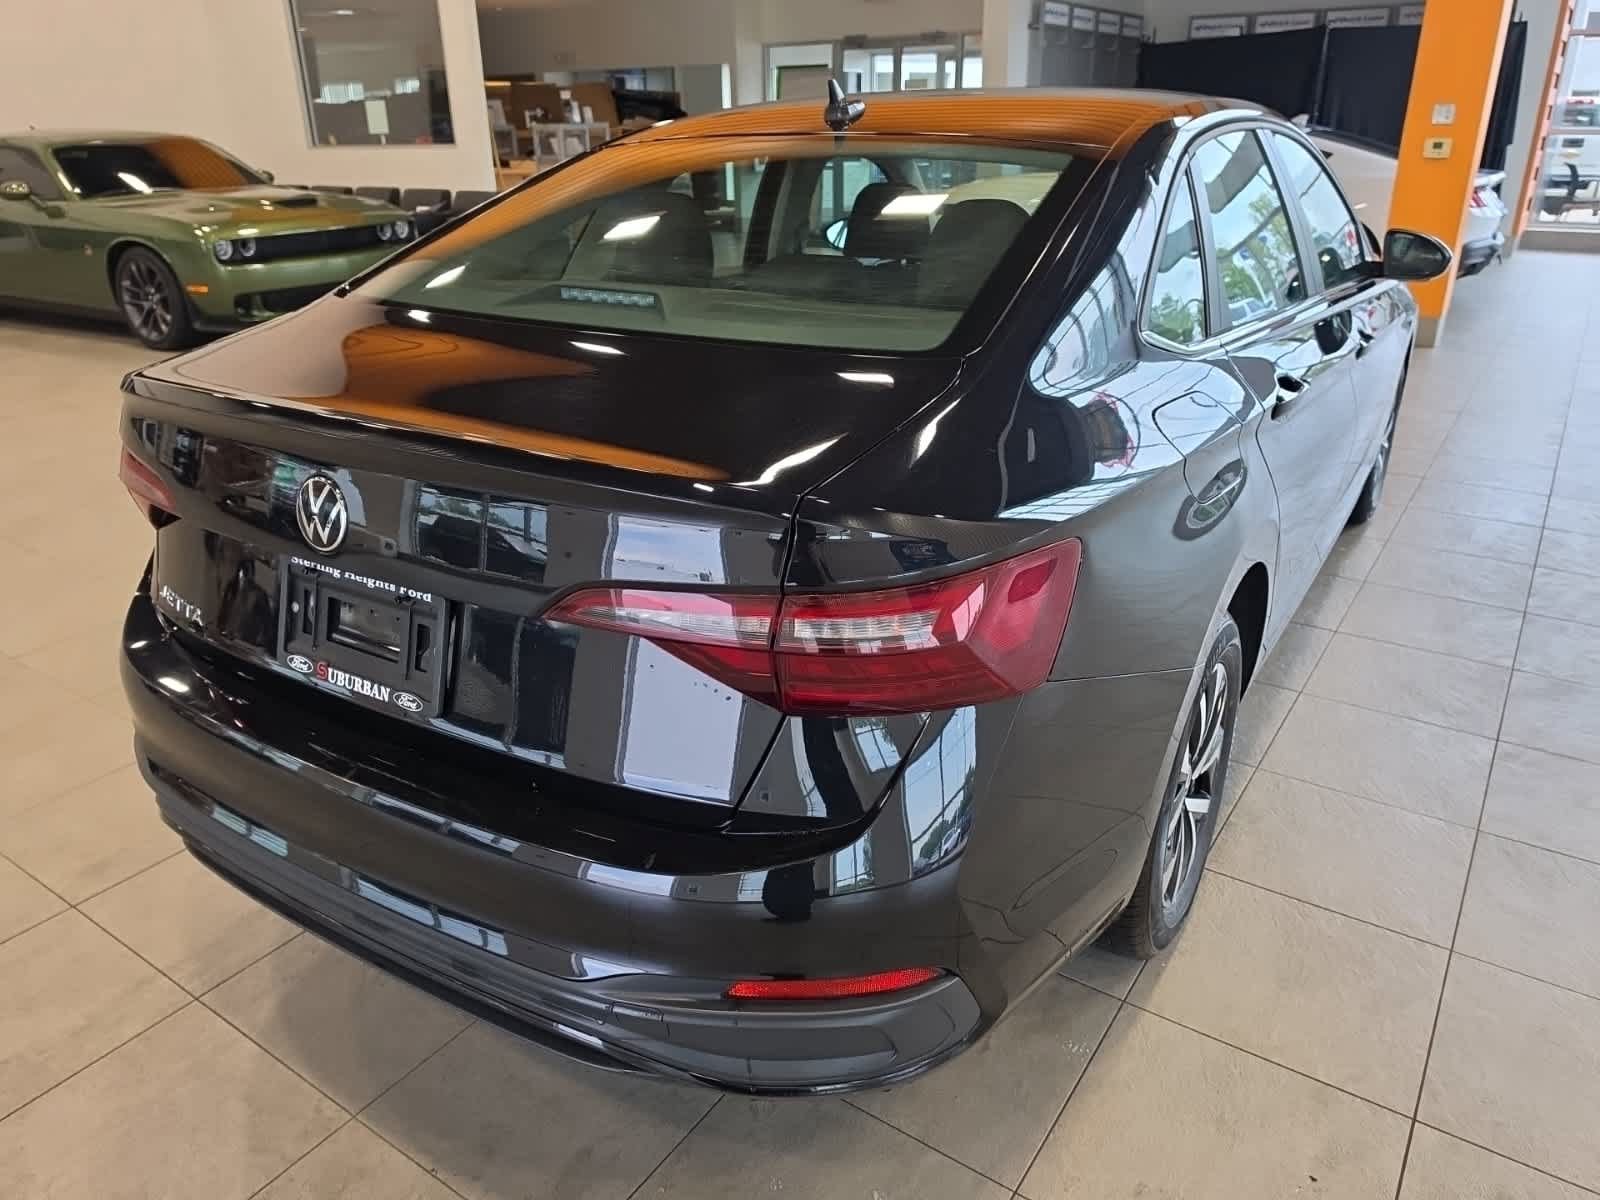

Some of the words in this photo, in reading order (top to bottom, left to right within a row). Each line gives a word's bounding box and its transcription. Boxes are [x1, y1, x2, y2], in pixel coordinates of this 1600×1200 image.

[298, 477, 346, 550] VW
[159, 585, 203, 626] JETTA
[290, 656, 310, 671] Ford
[316, 661, 391, 702] SUBURBAN
[397, 692, 418, 710] Ford
